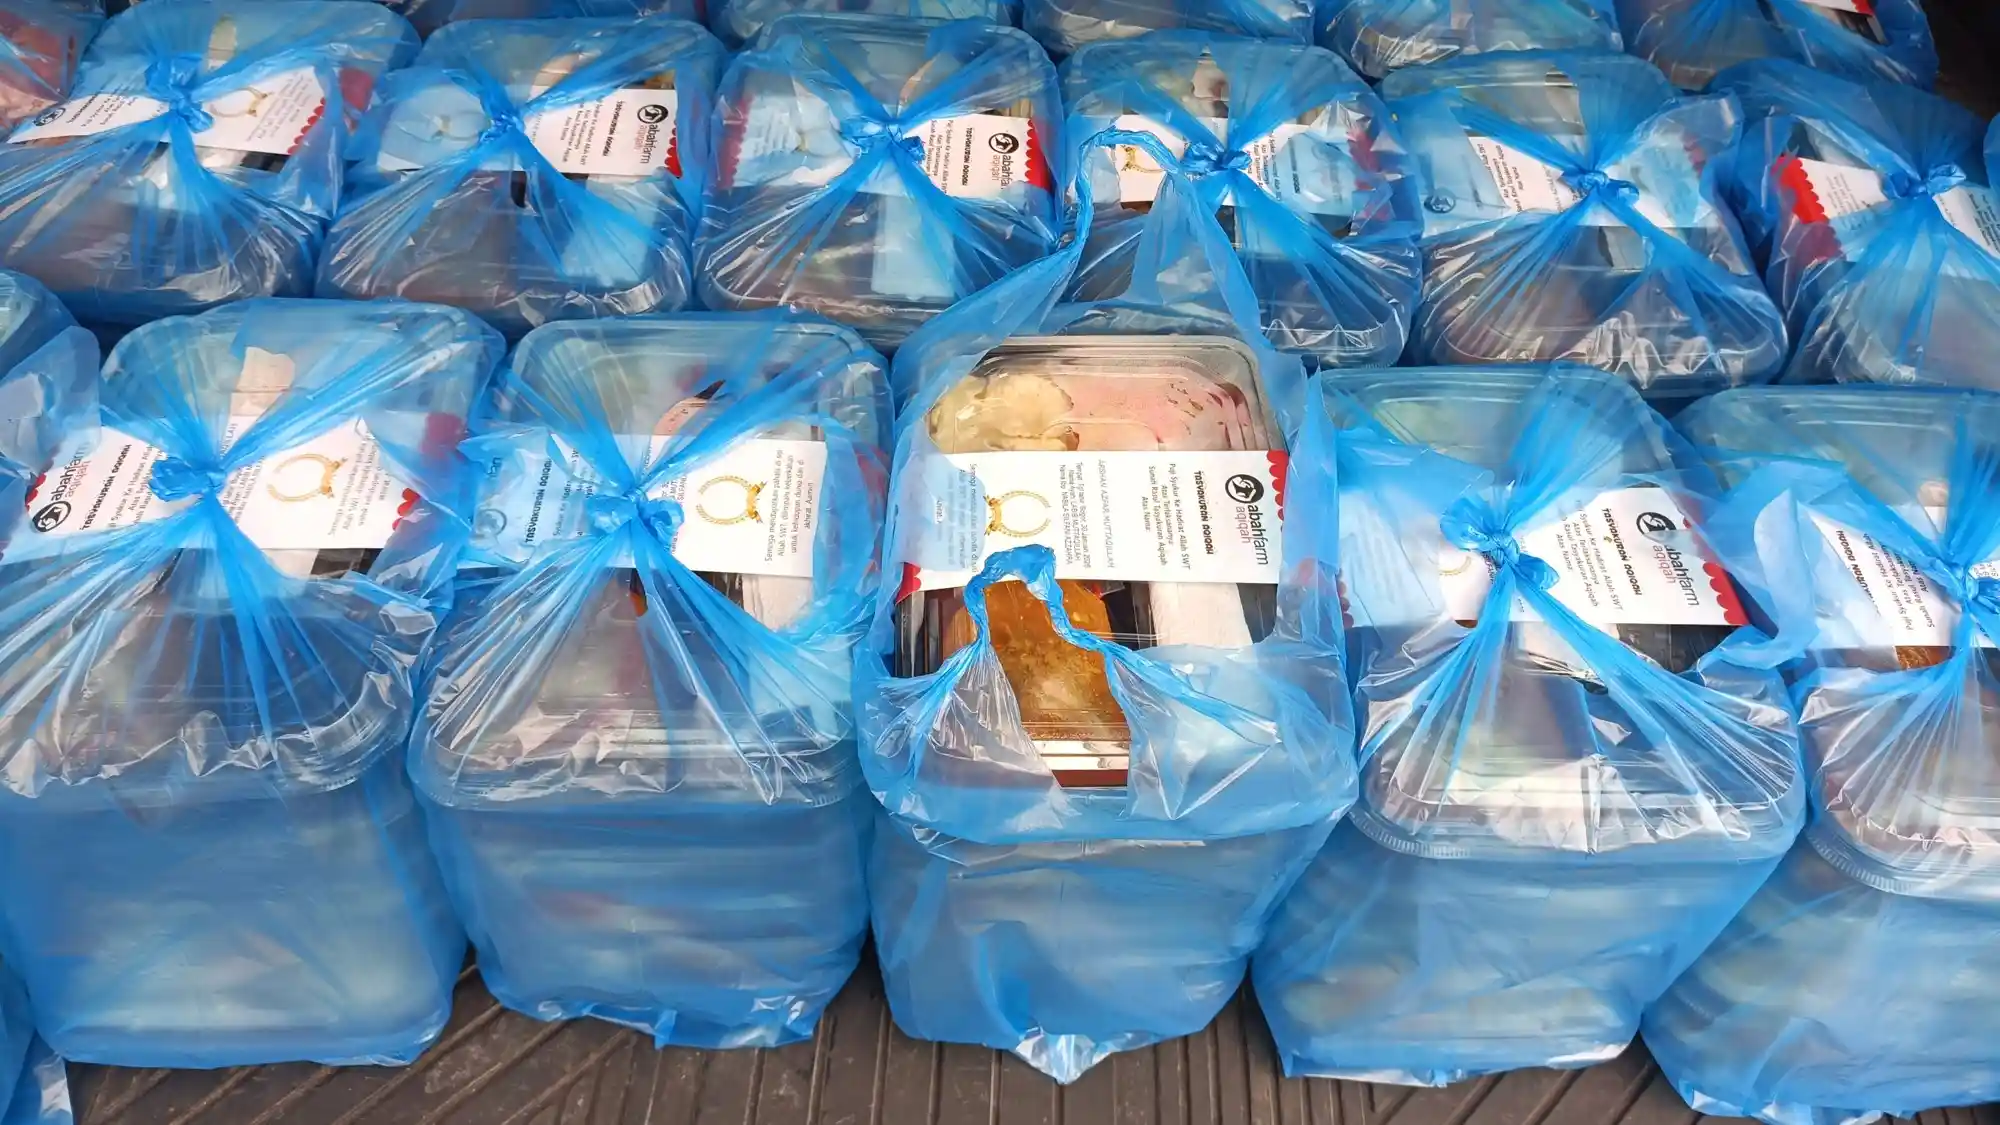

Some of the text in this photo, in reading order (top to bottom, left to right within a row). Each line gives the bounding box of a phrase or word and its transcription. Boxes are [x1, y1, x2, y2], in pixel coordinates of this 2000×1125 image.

[640, 124, 659, 163] abahfarm
[992, 155, 1000, 181] aqiqah
[49, 439, 90, 502] abahfarm
[64, 458, 91, 499] aqiqah
[1151, 486, 1160, 504] Rasul
[1169, 476, 1180, 498] Syukur
[524, 488, 545, 542] TASYAKURAN
[1174, 499, 1181, 508] Ke
[1194, 471, 1214, 555] TASYAKURAN AQIQAH
[1153, 505, 1164, 540] Tasyakuran
[1175, 509, 1185, 534] Hadirat
[1234, 506, 1253, 544] aqiqah
[1247, 504, 1272, 565] abahfarm
[765, 534, 776, 562] Semoga
[1156, 541, 1168, 566] Aqiqah
[1179, 534, 1188, 552] Allah
[1555, 533, 1567, 548] Atas
[1588, 536, 1598, 547] Ke
[1601, 508, 1643, 596] TASYAKURAN AQIQAH
[1836, 531, 1856, 560] AQIQAH
[1180, 553, 1191, 571] SWT
[1592, 548, 1609, 574] Hadirat
[1651, 544, 1678, 584] aqiqah
[1584, 581, 1600, 607] Aqiqah
[1603, 575, 1616, 592] Allah
[1610, 593, 1624, 611] SWT
